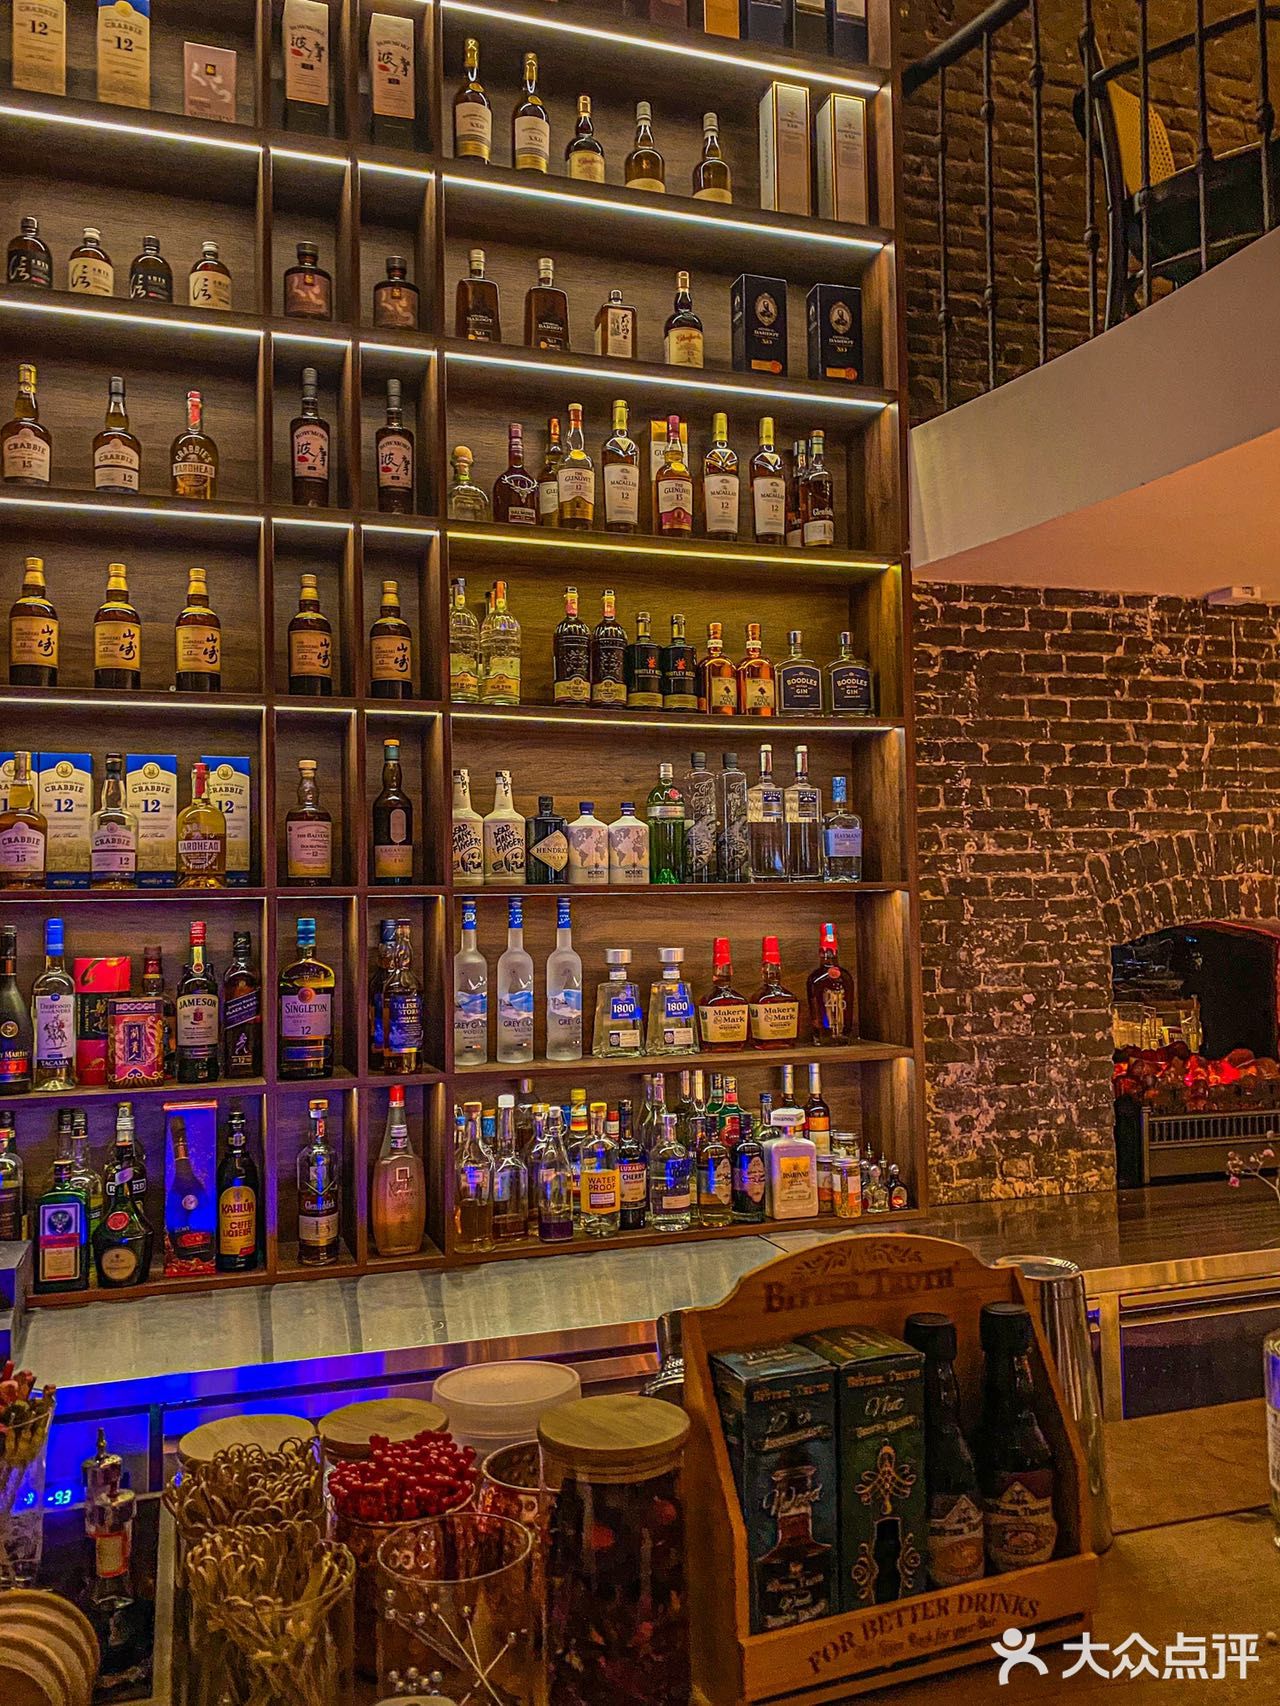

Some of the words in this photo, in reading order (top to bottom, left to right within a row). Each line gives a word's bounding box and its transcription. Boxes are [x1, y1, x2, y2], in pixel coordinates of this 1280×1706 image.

[30, 20, 48, 36] 12
[114, 36, 134, 52] 12
[7, 441, 46, 455] CRABBIE
[122, 472, 134, 483] 12
[621, 492, 630, 500] 12
[721, 501, 729, 509] 12
[786, 677, 817, 688] BOODLES
[837, 677, 868, 688] BOODLES
[44, 784, 85, 793] CRABBIE
[132, 785, 171, 794] CRABBIE
[54, 799, 74, 812] 12
[141, 799, 161, 813] 12
[1, 836, 41, 846] CRABBIE
[94, 837, 131, 847] CRABBIE
[15, 854, 26, 863] 15
[119, 856, 130, 865] 12
[179, 998, 216, 1009] JAMESON
[285, 1002, 327, 1013] SINGLETON
[613, 1003, 634, 1013] 1800
[667, 1002, 688, 1011] 1800
[301, 1026, 311, 1035] 12
[589, 1183, 615, 1191] PROOF
[808, 1631, 854, 1674] FOR
[862, 1599, 950, 1641] BETTER
[957, 1591, 1041, 1619] DRINKS
